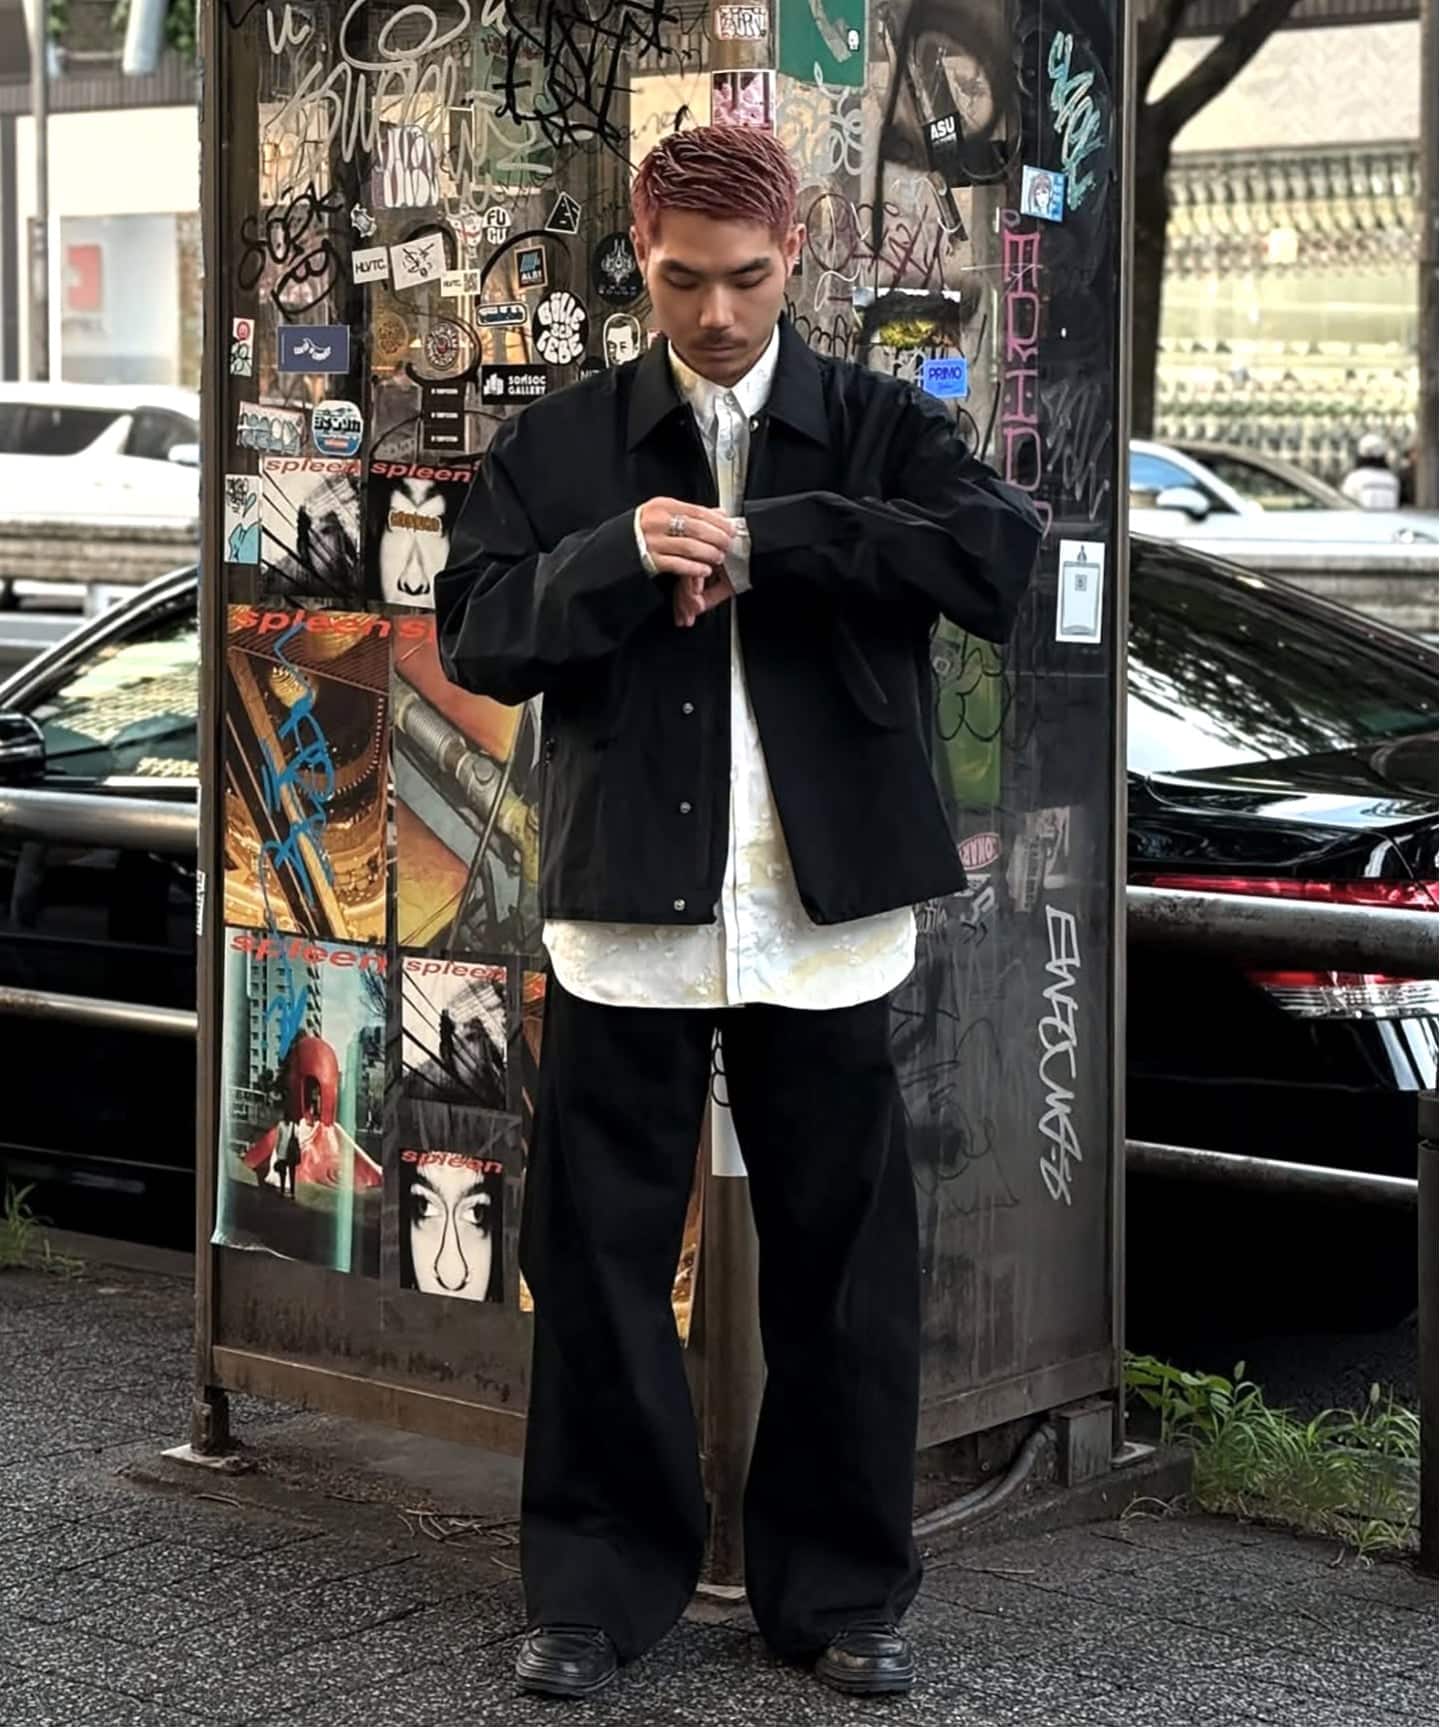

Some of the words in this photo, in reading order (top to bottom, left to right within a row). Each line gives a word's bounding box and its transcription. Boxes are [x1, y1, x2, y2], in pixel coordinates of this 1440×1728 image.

[930, 115, 955, 141] ASU
[928, 366, 962, 380] PRIMO
[507, 385, 547, 396] GALLERY
[265, 457, 362, 476] spleen
[370, 460, 472, 483] spleen
[232, 608, 392, 638] spleen
[229, 934, 388, 975] spleen
[405, 960, 507, 981] spleen
[401, 1149, 504, 1174] spleen
